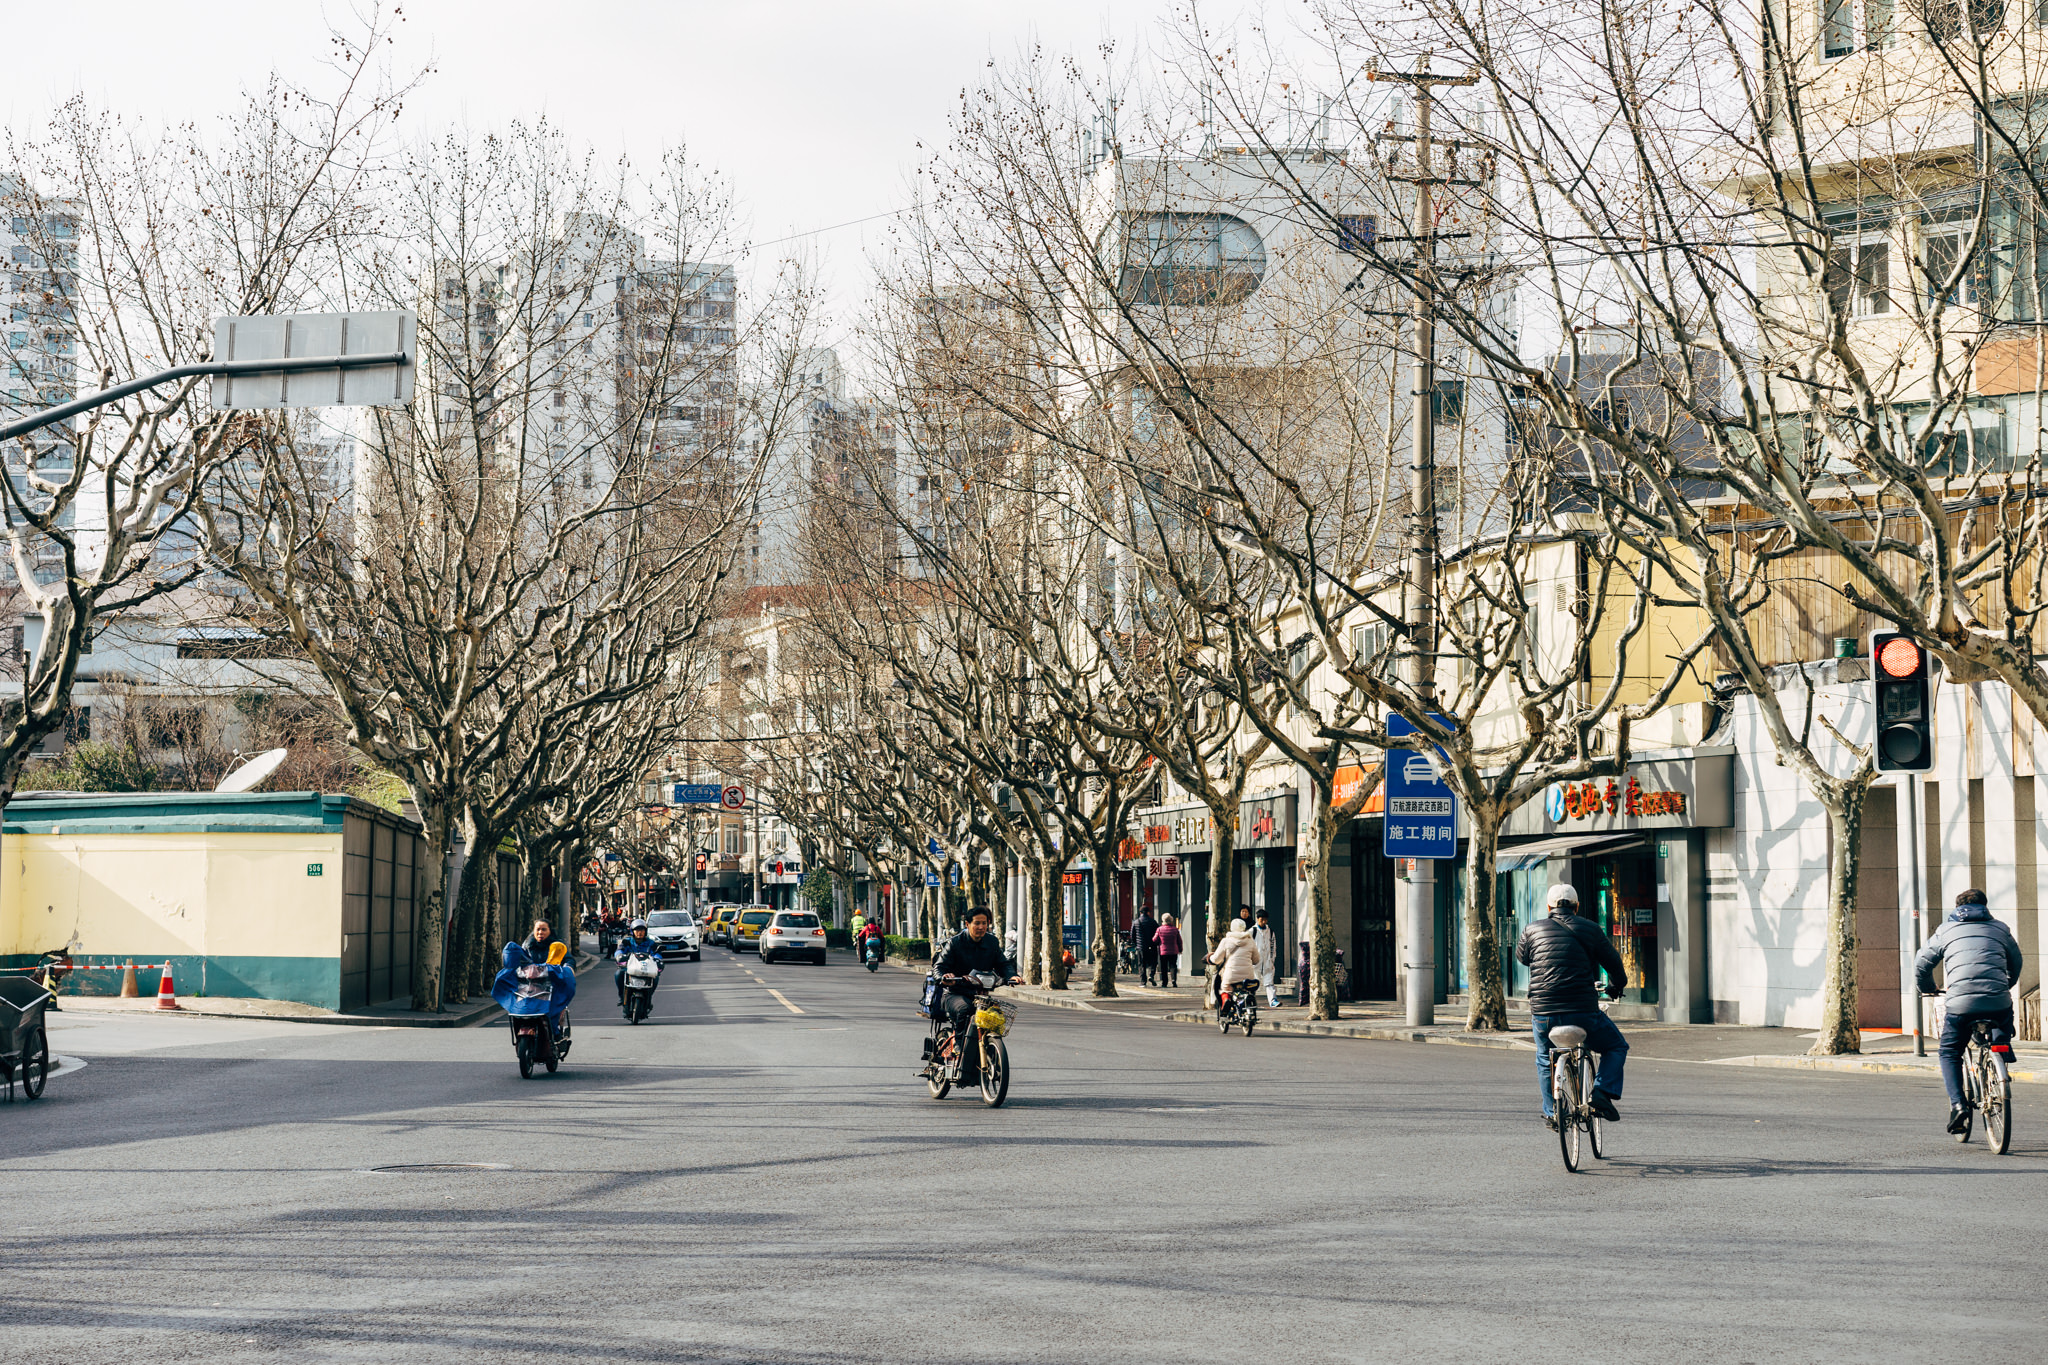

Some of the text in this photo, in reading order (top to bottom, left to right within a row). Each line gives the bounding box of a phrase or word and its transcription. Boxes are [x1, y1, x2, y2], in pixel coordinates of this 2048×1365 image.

[1564, 775, 1640, 818] 电池专卖
[1392, 801, 1449, 812] 万航渡路武定西路口
[1389, 825, 1452, 841] 施工期间
[1149, 858, 1178, 876] 刻章
